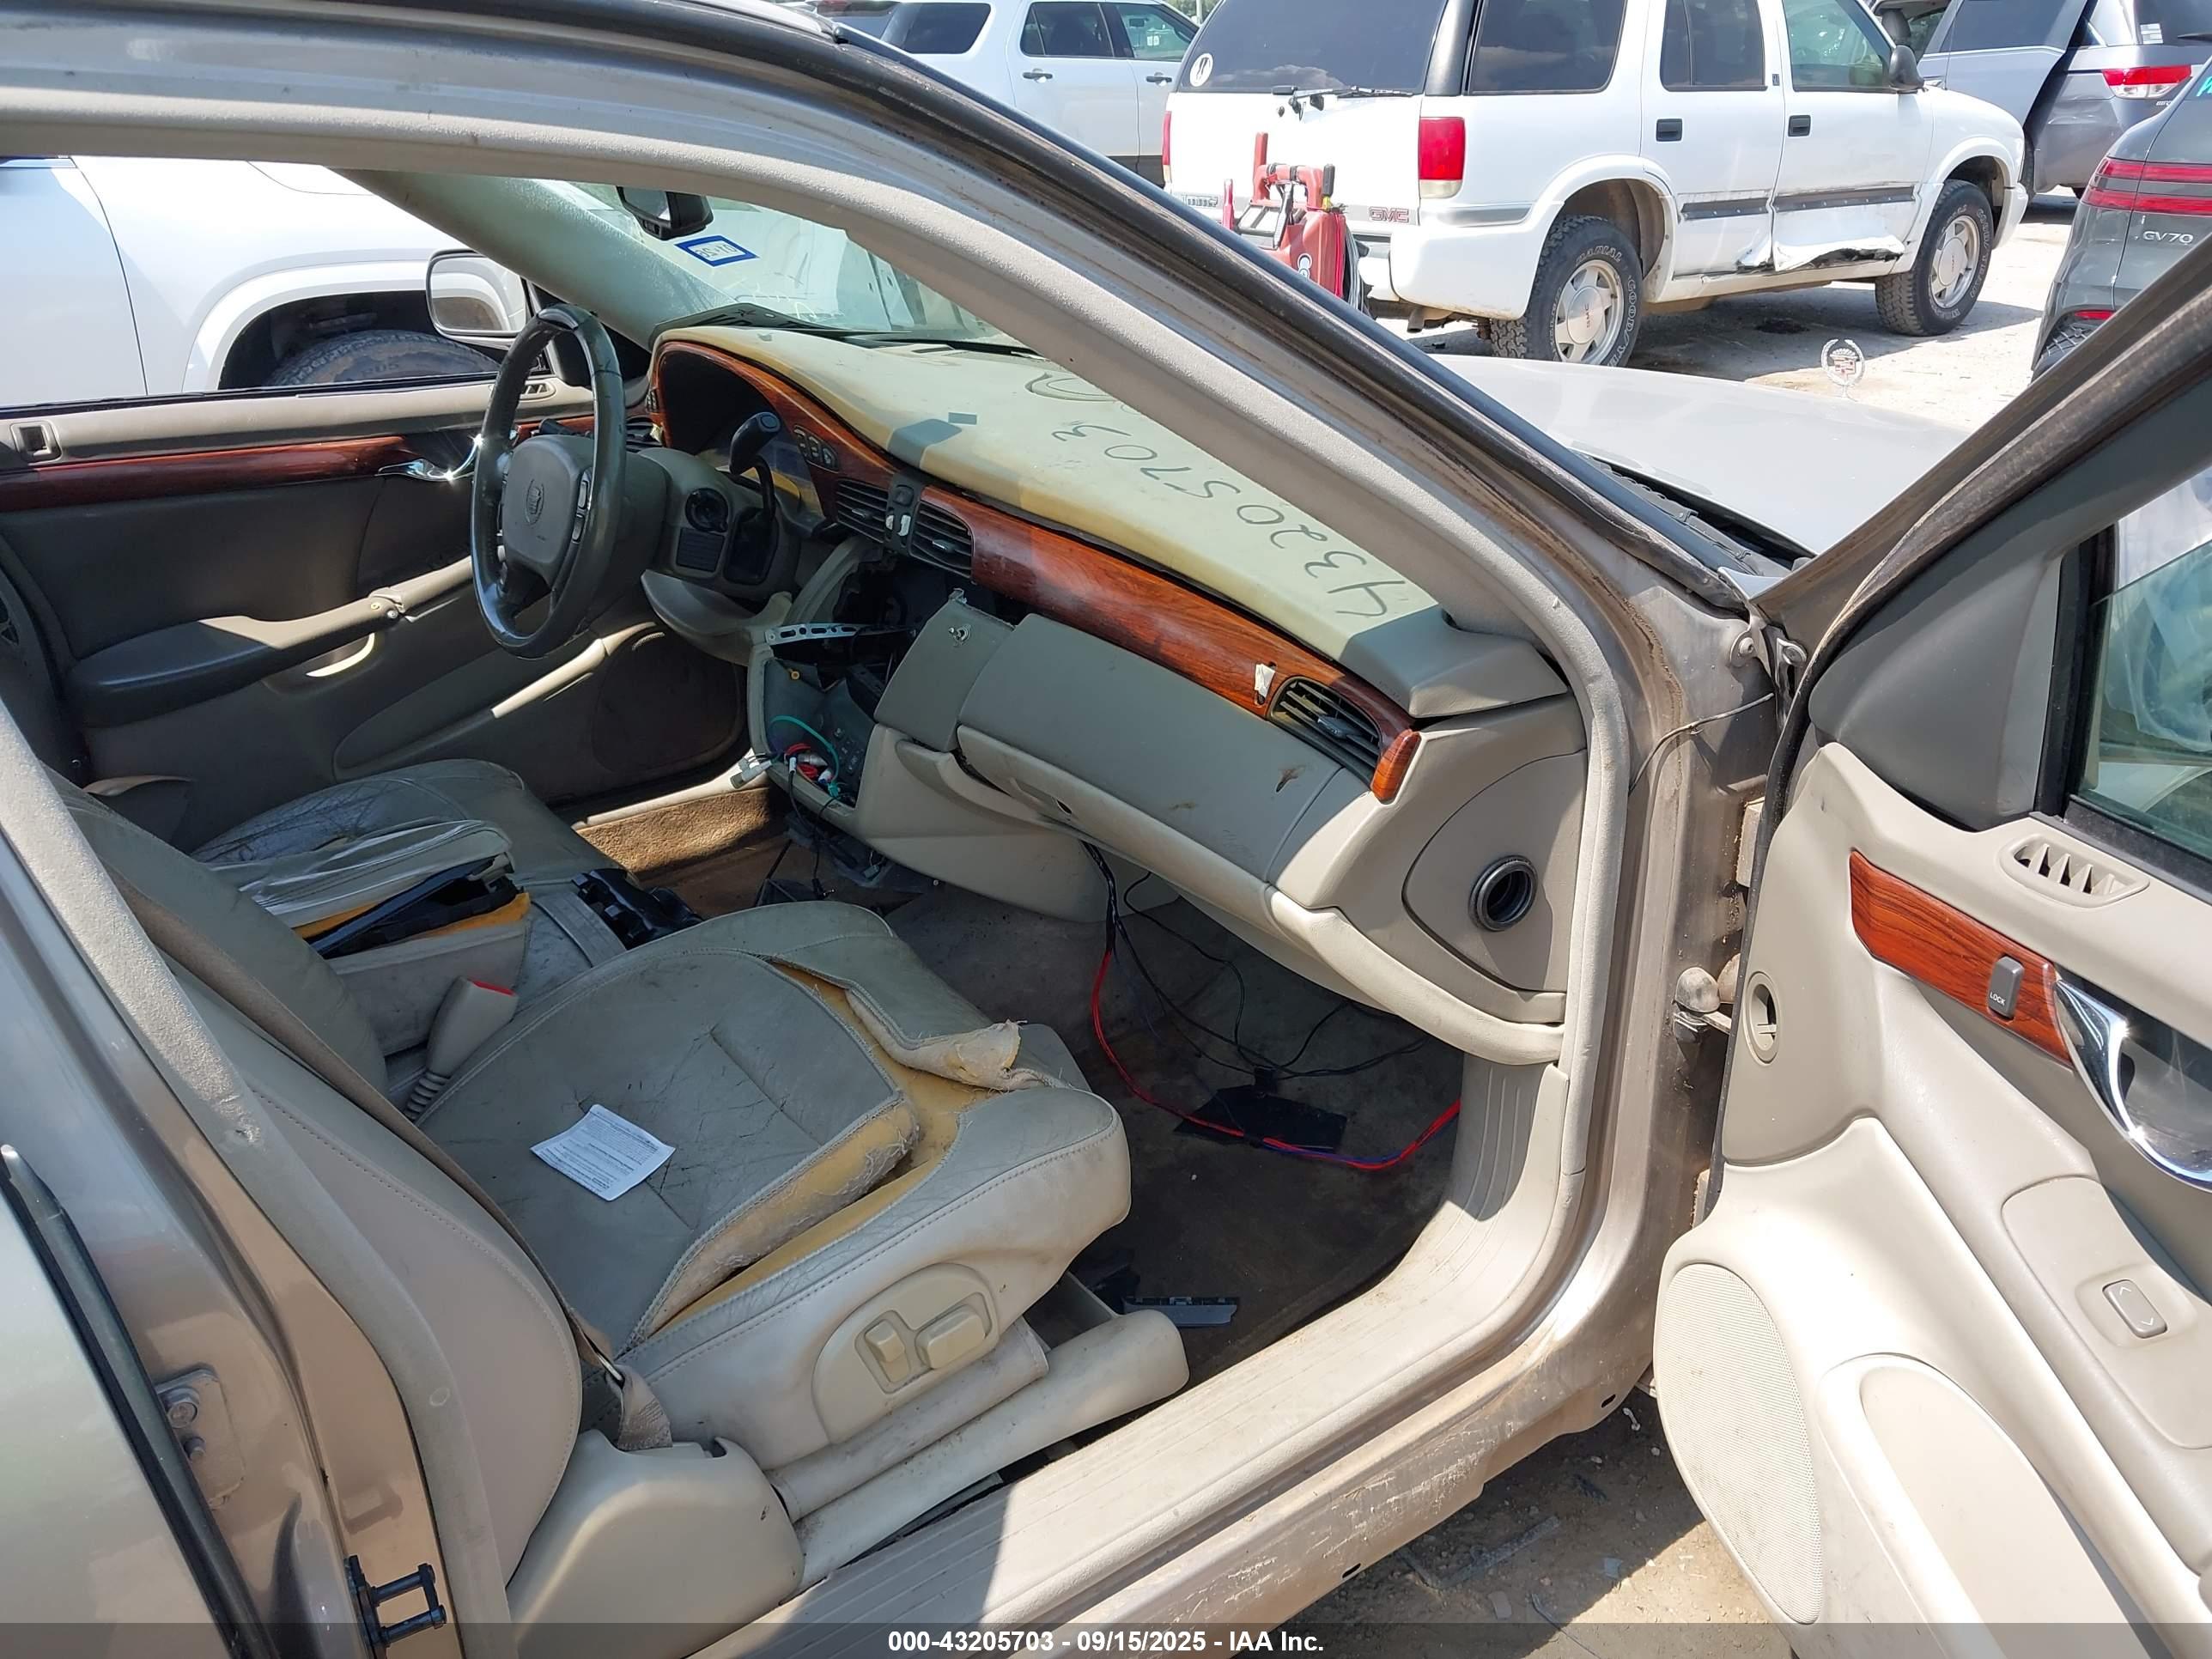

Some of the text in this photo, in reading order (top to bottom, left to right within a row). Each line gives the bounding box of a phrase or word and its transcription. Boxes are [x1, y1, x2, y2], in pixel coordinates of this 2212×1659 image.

[1369, 206, 1410, 223] GMC
[2142, 230, 2194, 245] GV70
[1052, 422, 1407, 618] 43205703
[1990, 991, 2006, 1006] LOCK
